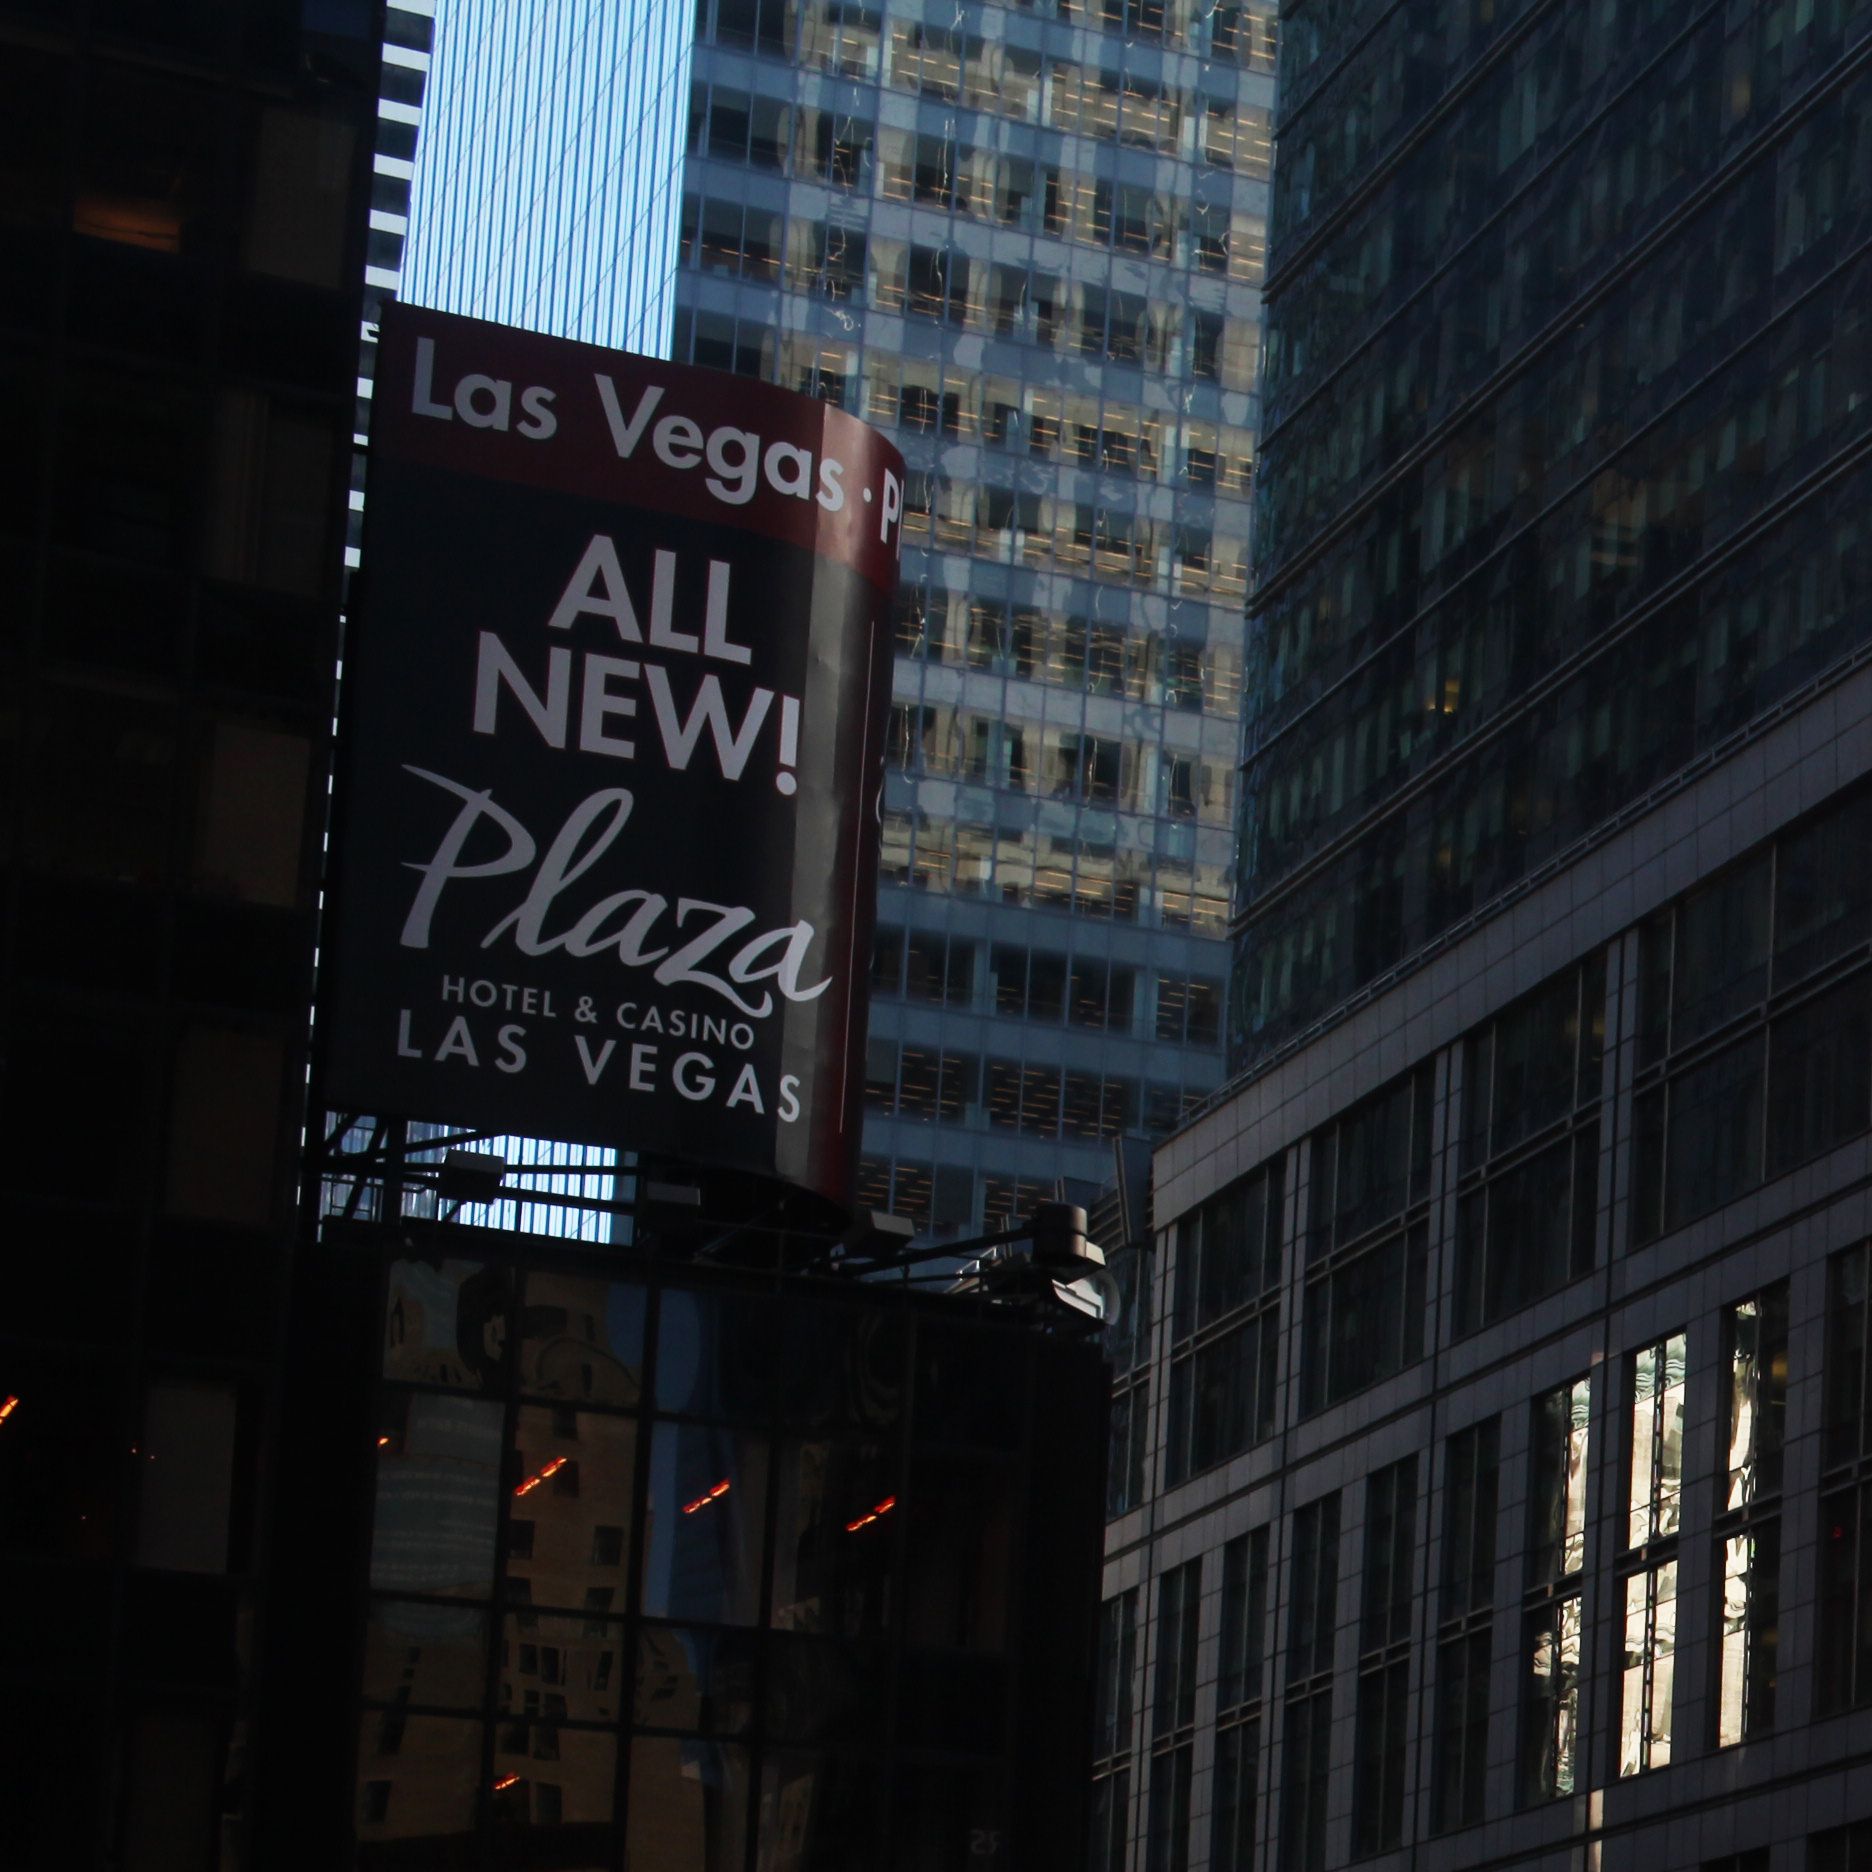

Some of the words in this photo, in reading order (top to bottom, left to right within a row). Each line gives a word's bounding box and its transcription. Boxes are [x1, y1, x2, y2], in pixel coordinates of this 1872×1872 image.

[411, 337, 559, 441] Las
[594, 372, 845, 512] Vegas
[879, 467, 903, 560] P
[547, 533, 754, 666] ALL
[470, 630, 803, 795] NEW!
[401, 763, 833, 1018] Plaza
[397, 1008, 529, 1075] LAS
[574, 1037, 803, 1123] VEGAS
[441, 972, 557, 1019] HOTEL
[575, 995, 598, 1025] &
[616, 1000, 756, 1051] CASINO
